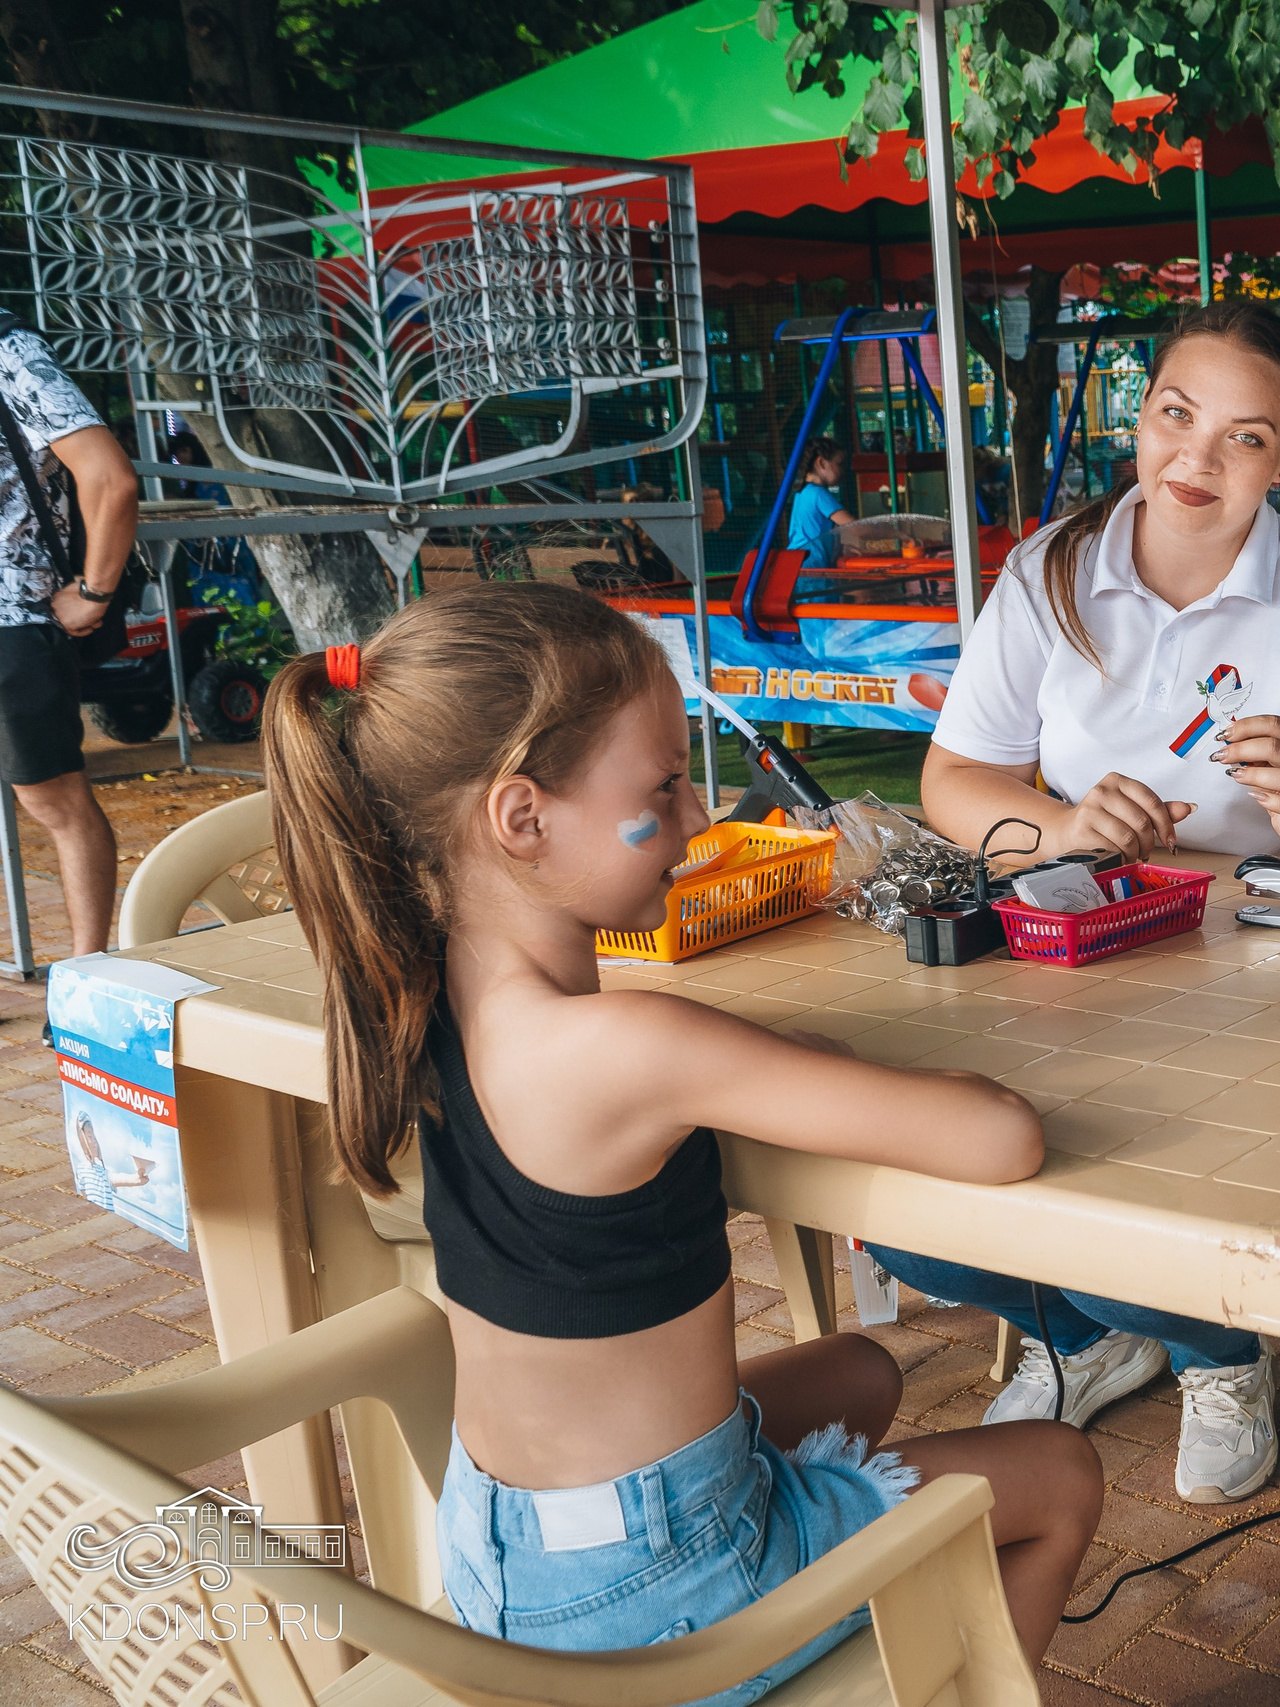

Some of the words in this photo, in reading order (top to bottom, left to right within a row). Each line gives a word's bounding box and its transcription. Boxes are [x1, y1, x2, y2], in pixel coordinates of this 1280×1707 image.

[766, 667, 898, 704] HOCKEY
[59, 1036, 90, 1058] АКЦИЯ
[60, 1060, 108, 1095] «ПИСЬМО
[110, 1082, 169, 1117] СОЛДАТУ»
